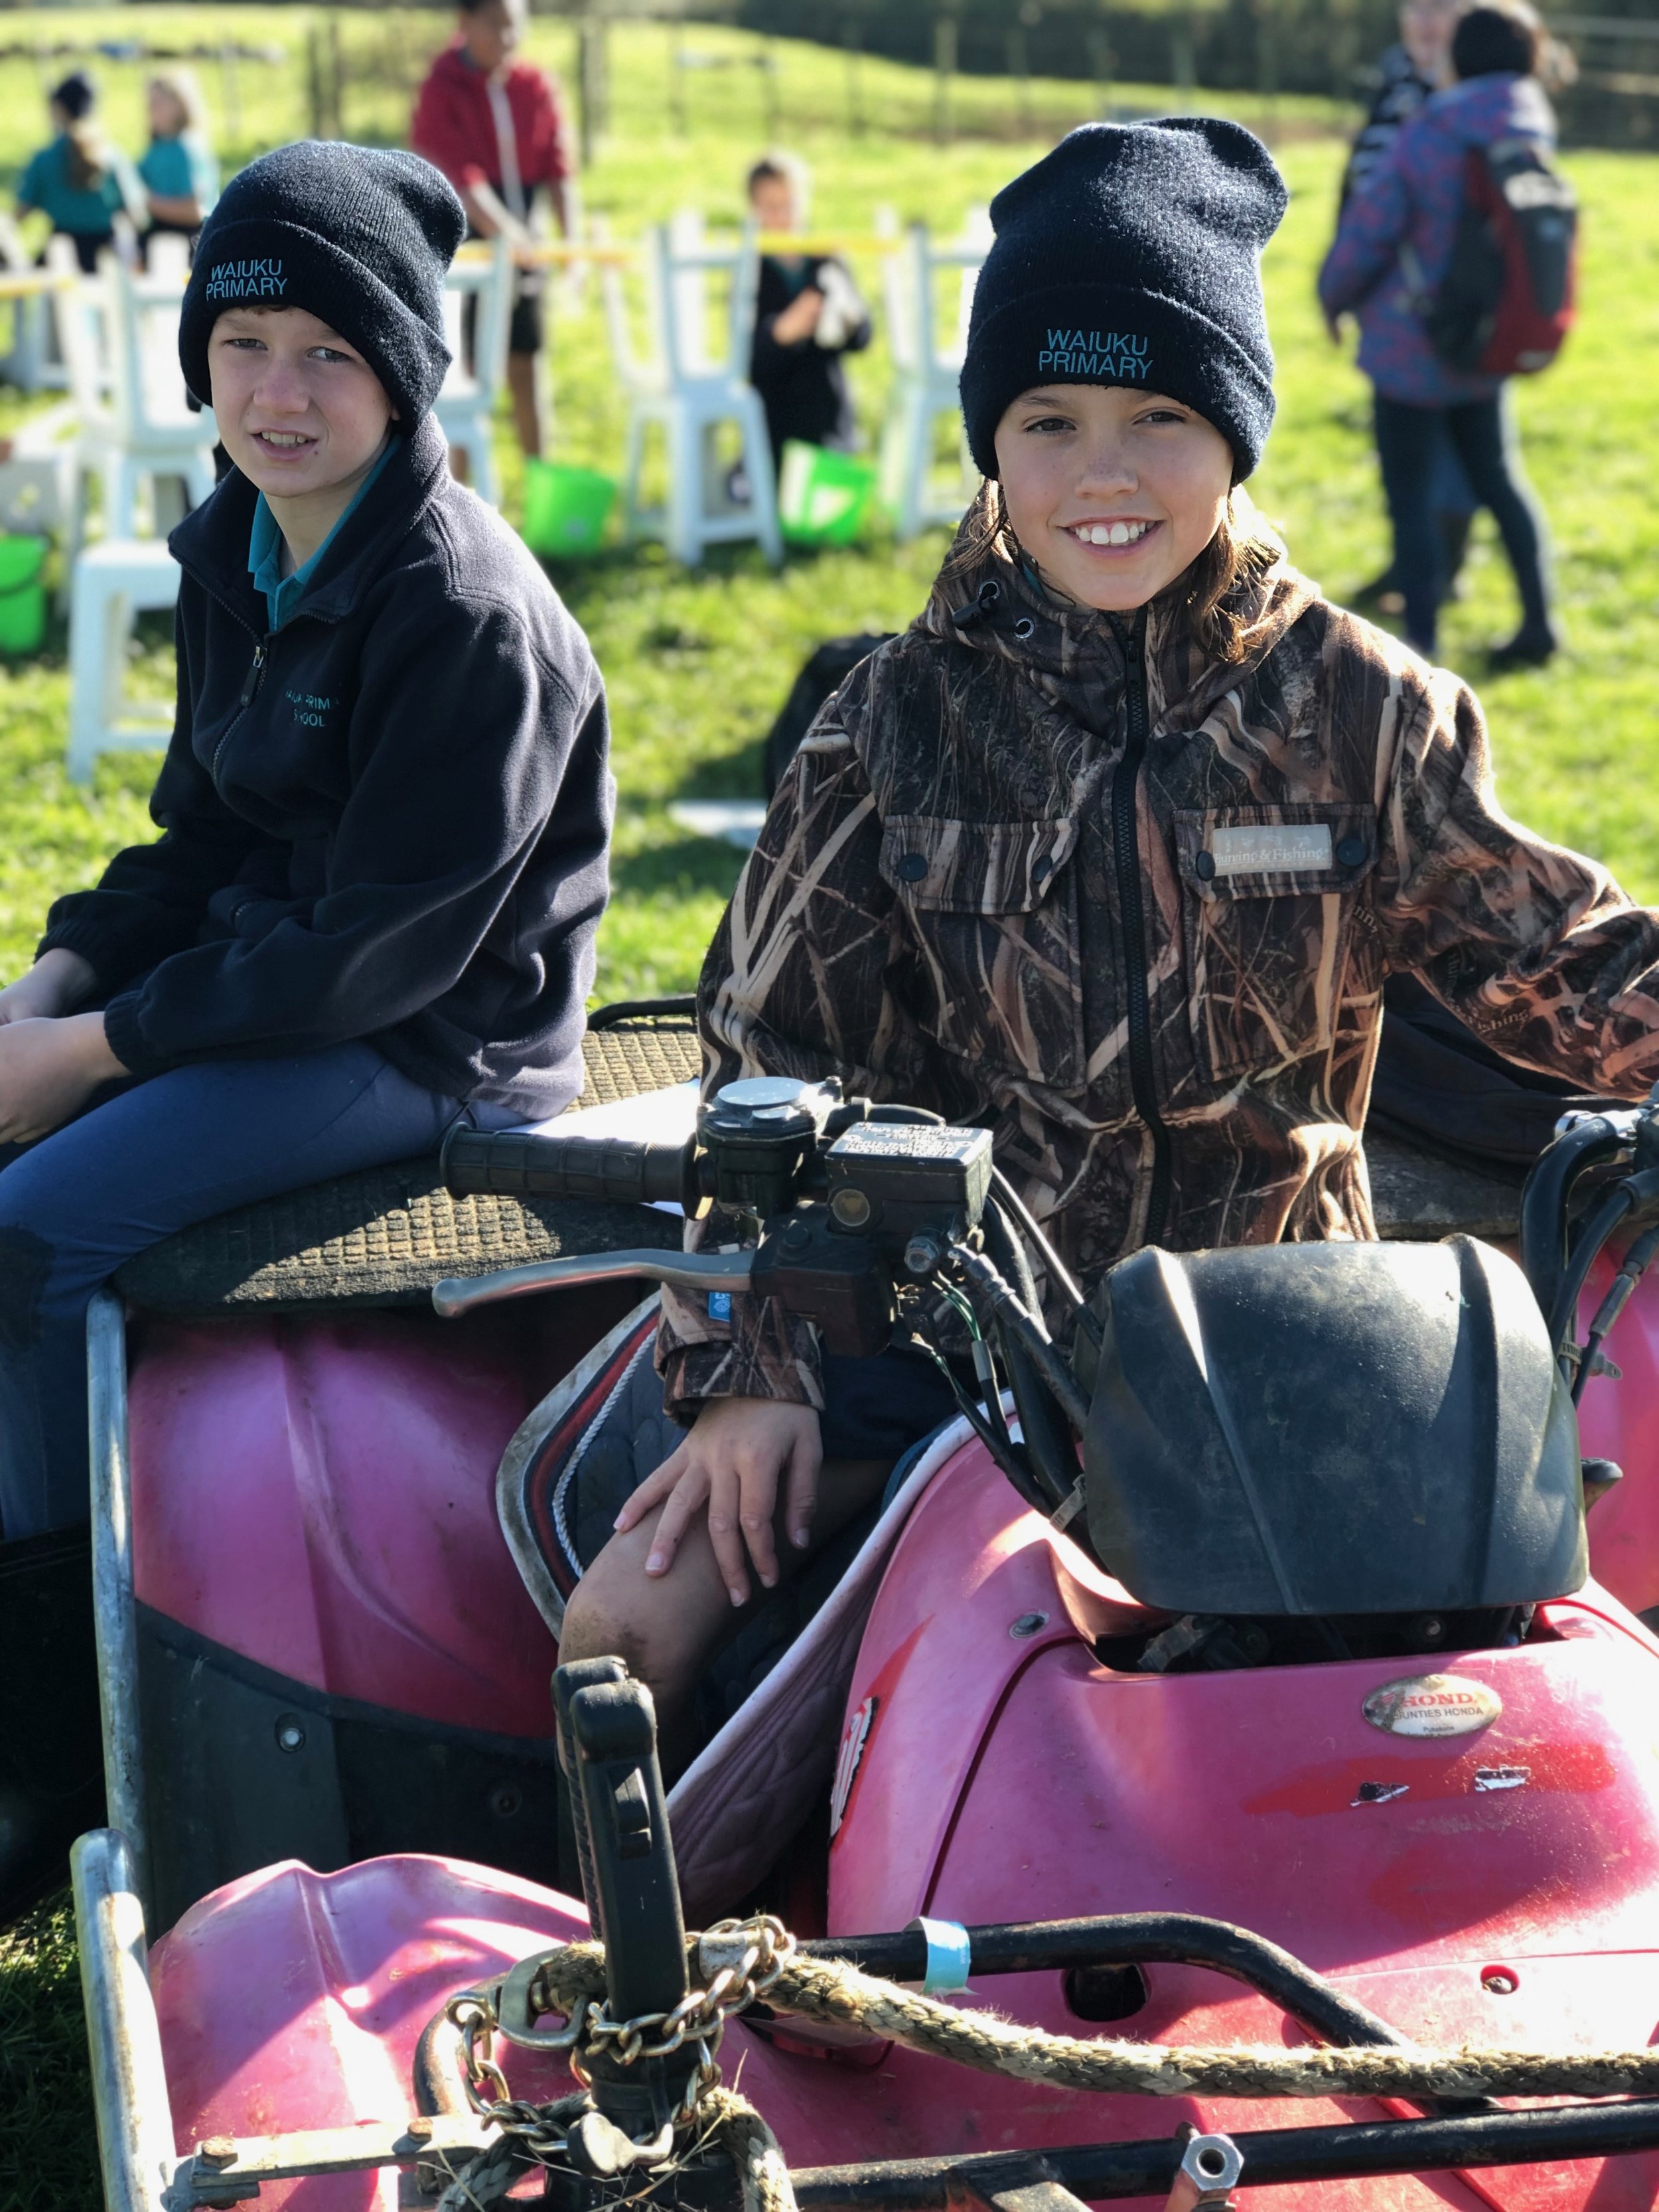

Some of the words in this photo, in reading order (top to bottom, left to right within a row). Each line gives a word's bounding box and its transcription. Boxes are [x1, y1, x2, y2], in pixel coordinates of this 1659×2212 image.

[212, 258, 281, 282] WAIUKU
[206, 277, 287, 301] PRIMARY
[1047, 329, 1148, 356] WAIUKU
[1039, 350, 1154, 379] PRIMARY
[293, 708, 328, 727] SOOL
[1260, 849, 1270, 861] &
[1273, 846, 1323, 862] Fishing
[1402, 1693, 1476, 1707] HOND
[1444, 1707, 1484, 1716] HONDA
